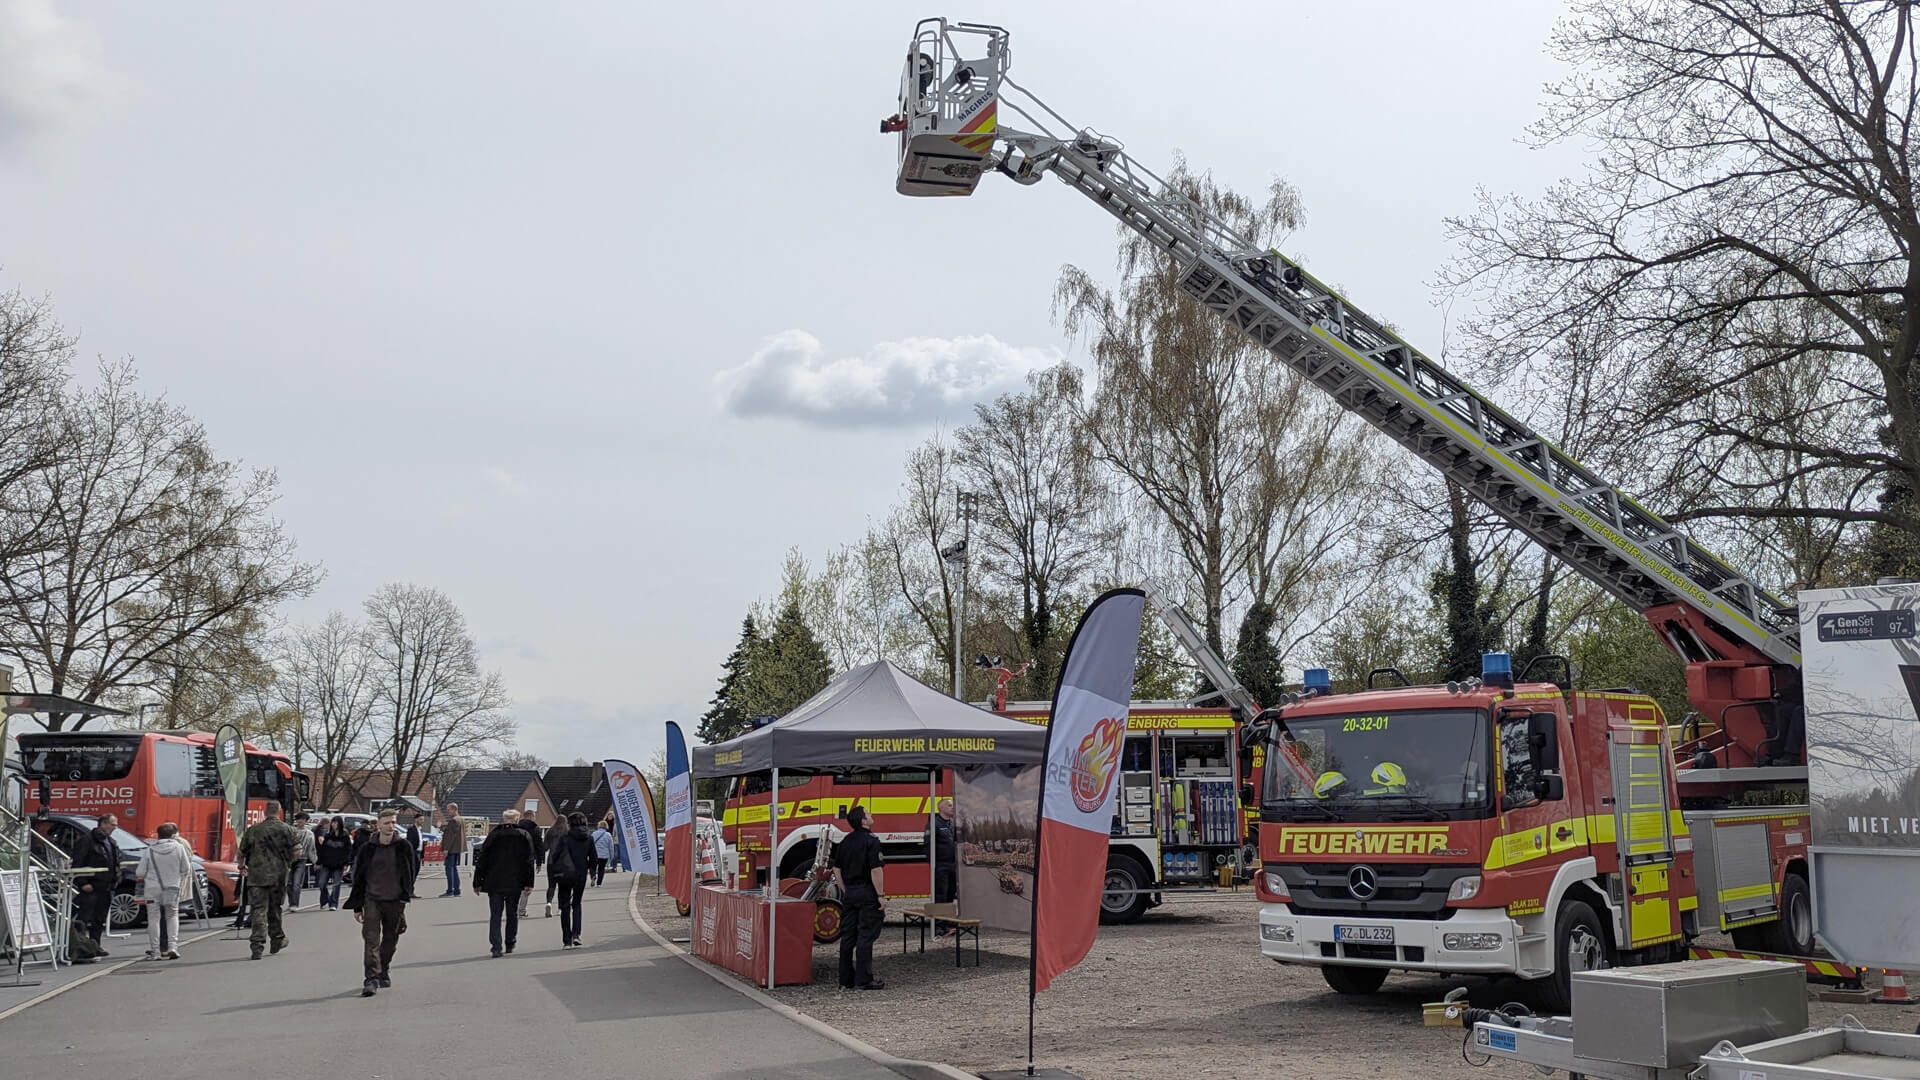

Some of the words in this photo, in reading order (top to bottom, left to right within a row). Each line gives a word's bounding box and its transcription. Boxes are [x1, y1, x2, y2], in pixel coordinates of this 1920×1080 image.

[958, 91, 993, 121] MAGIRUS
[1837, 614, 1875, 628] GenSet
[1889, 622, 1902, 634] 97
[1128, 718, 1177, 729] ENBURG
[1343, 716, 1389, 732] 20-32-01
[854, 737, 926, 753] FEUERWEHR
[928, 738, 996, 752] LAUENBURG
[1047, 761, 1098, 794] RETTER
[24, 784, 134, 800] ESERING
[624, 788, 652, 862] JUGENDFEUERWEHR
[1279, 826, 1450, 855] FEUERWEHR
[1340, 927, 1353, 939] RZ
[1359, 928, 1372, 939] DL
[1373, 928, 1392, 940] 232
